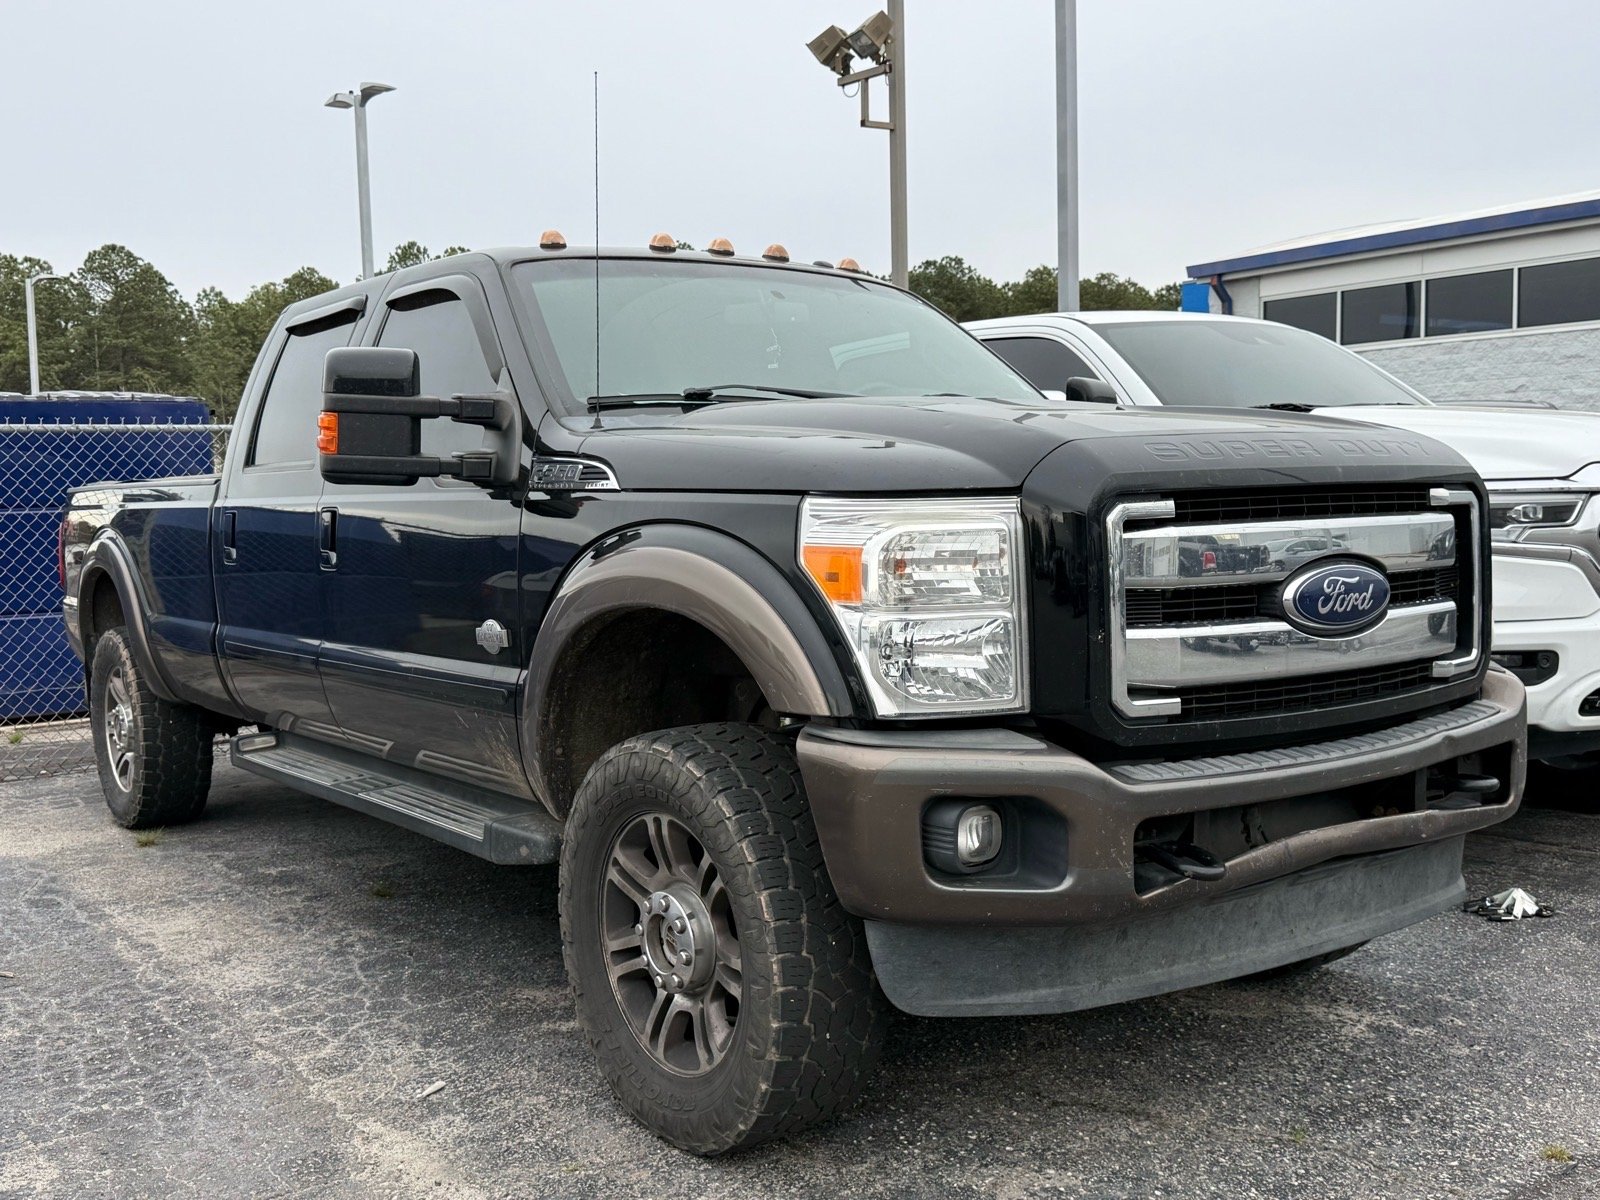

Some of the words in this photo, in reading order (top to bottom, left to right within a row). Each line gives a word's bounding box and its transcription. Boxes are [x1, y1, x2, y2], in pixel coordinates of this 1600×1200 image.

[1144, 439, 1321, 462] SUPER
[1328, 439, 1432, 457] DUTY
[1318, 576, 1374, 615] Ford
